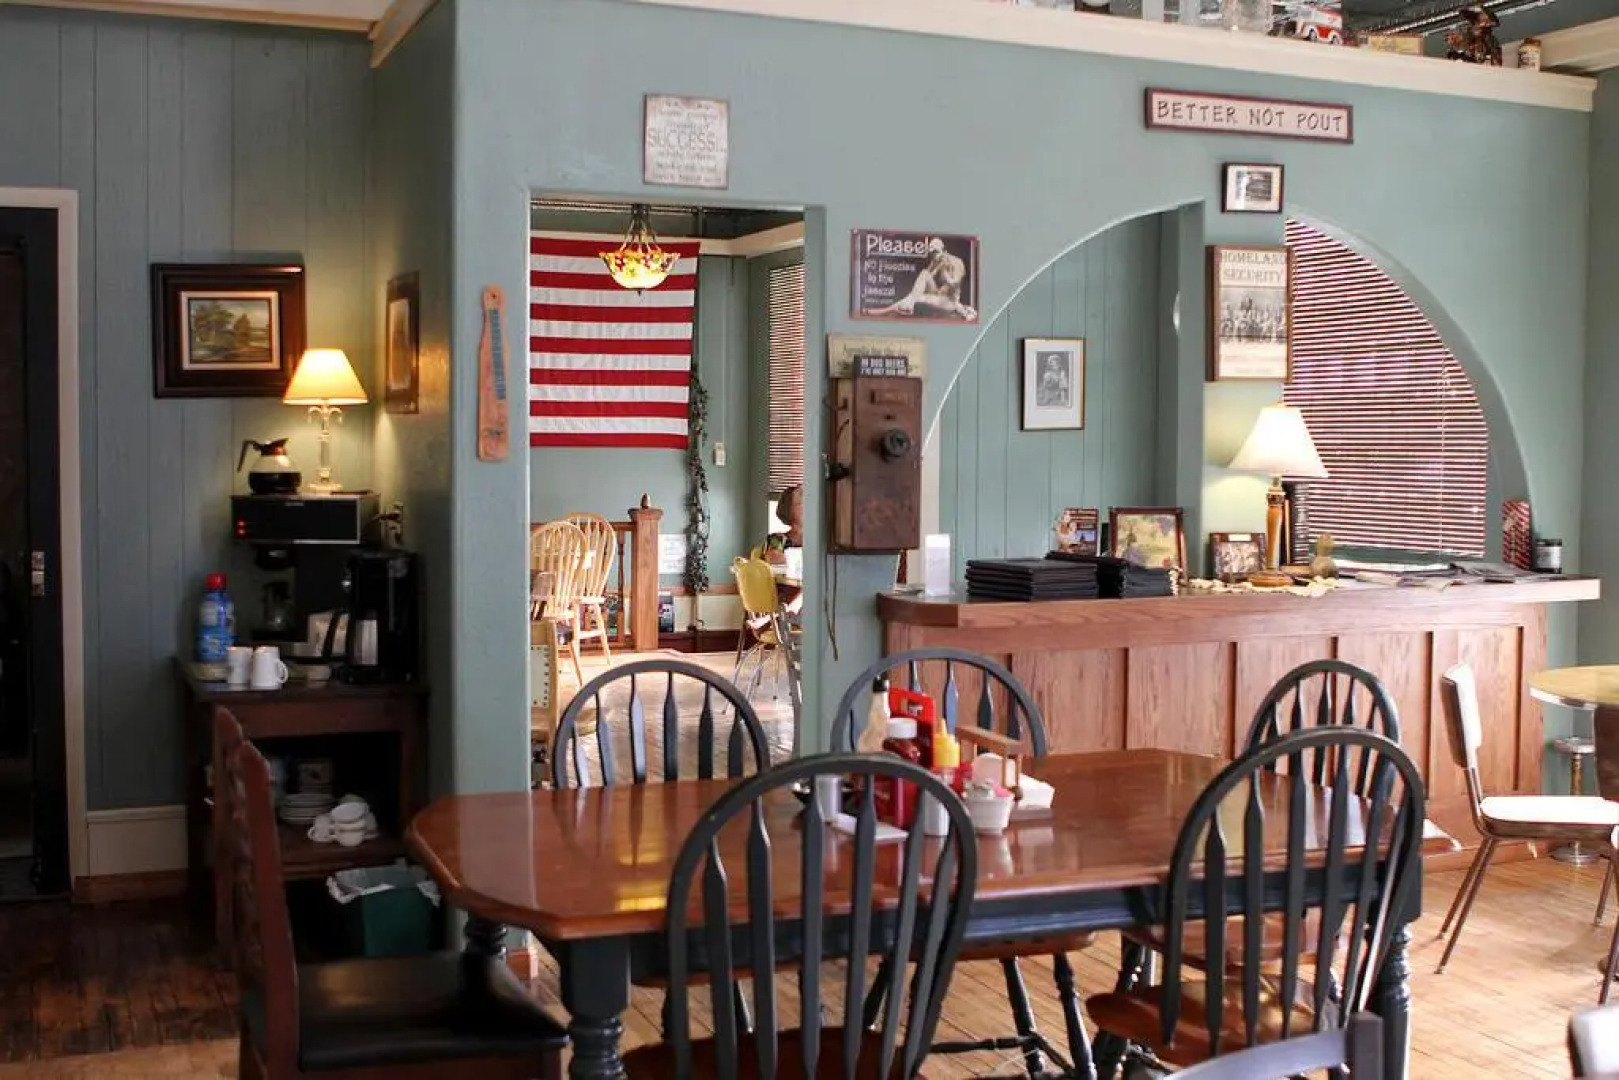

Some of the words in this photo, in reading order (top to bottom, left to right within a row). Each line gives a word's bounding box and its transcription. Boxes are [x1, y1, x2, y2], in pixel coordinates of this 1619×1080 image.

[1156, 100, 1238, 124] BETTER
[1249, 108, 1285, 128] NOT
[1297, 113, 1343, 133] POUT
[1223, 269, 1284, 284] SECURITY
